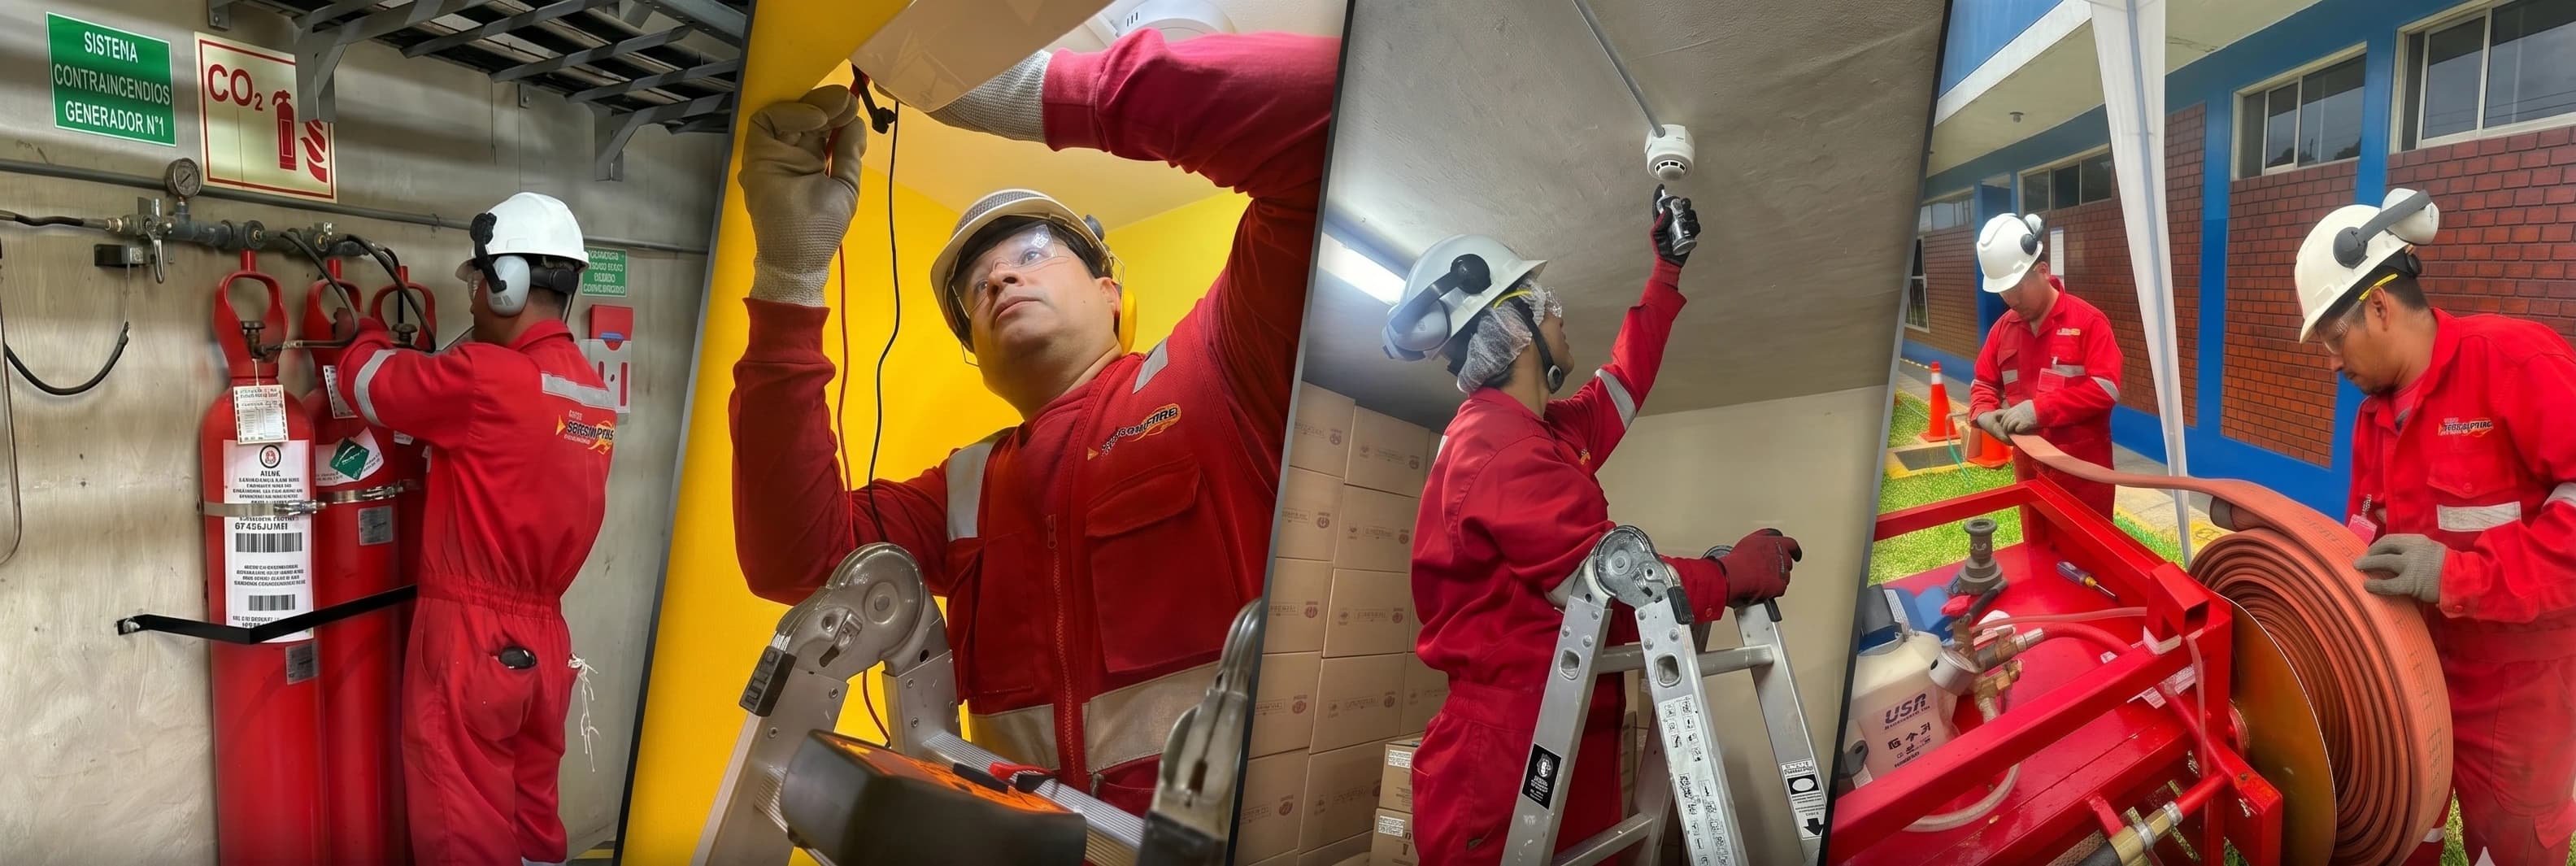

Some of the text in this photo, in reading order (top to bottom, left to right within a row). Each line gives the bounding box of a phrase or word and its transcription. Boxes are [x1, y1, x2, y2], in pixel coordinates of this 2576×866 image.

[85, 31, 138, 63] SISTEMA
[54, 63, 171, 106] CONTRAINCENDIOS
[65, 100, 144, 133] GENERADOR
